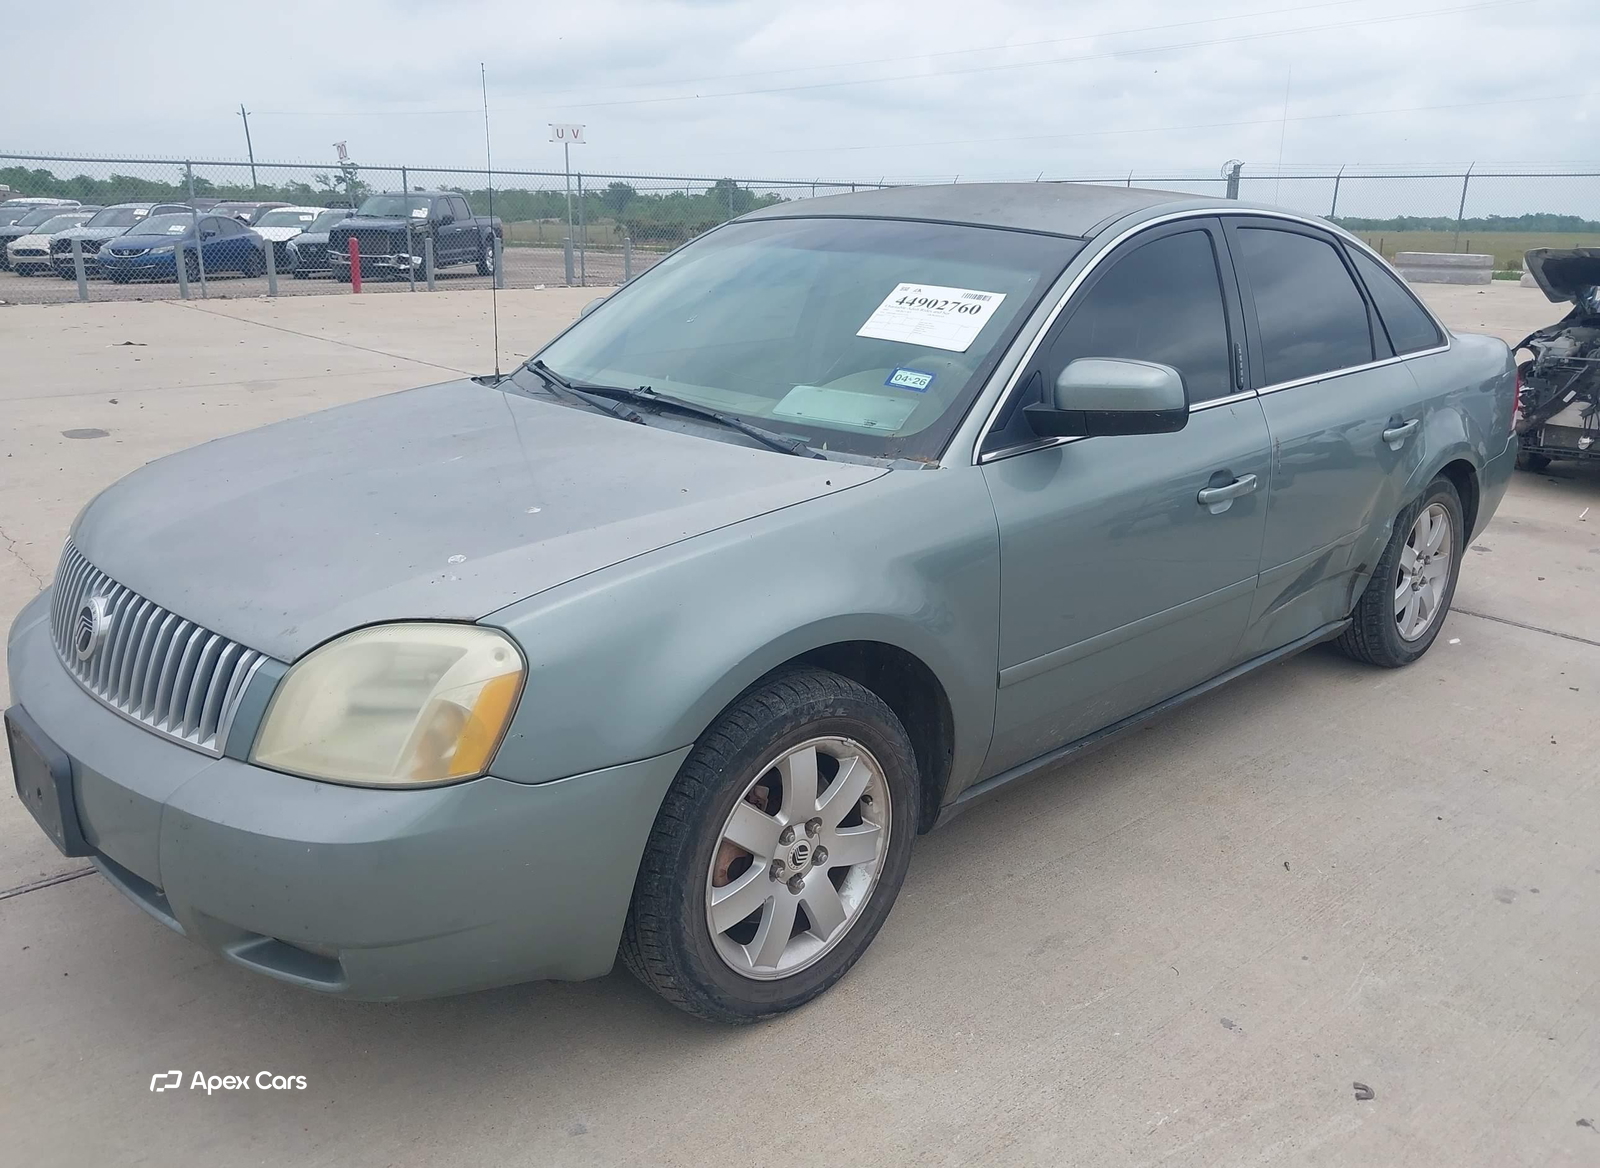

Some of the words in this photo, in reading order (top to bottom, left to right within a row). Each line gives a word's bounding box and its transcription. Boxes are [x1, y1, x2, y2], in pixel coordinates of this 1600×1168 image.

[556, 128, 564, 139] U
[571, 128, 580, 139] V
[336, 143, 348, 160] 20
[895, 295, 982, 316] 44902760
[894, 374, 909, 382] 04
[912, 377, 928, 386] 26
